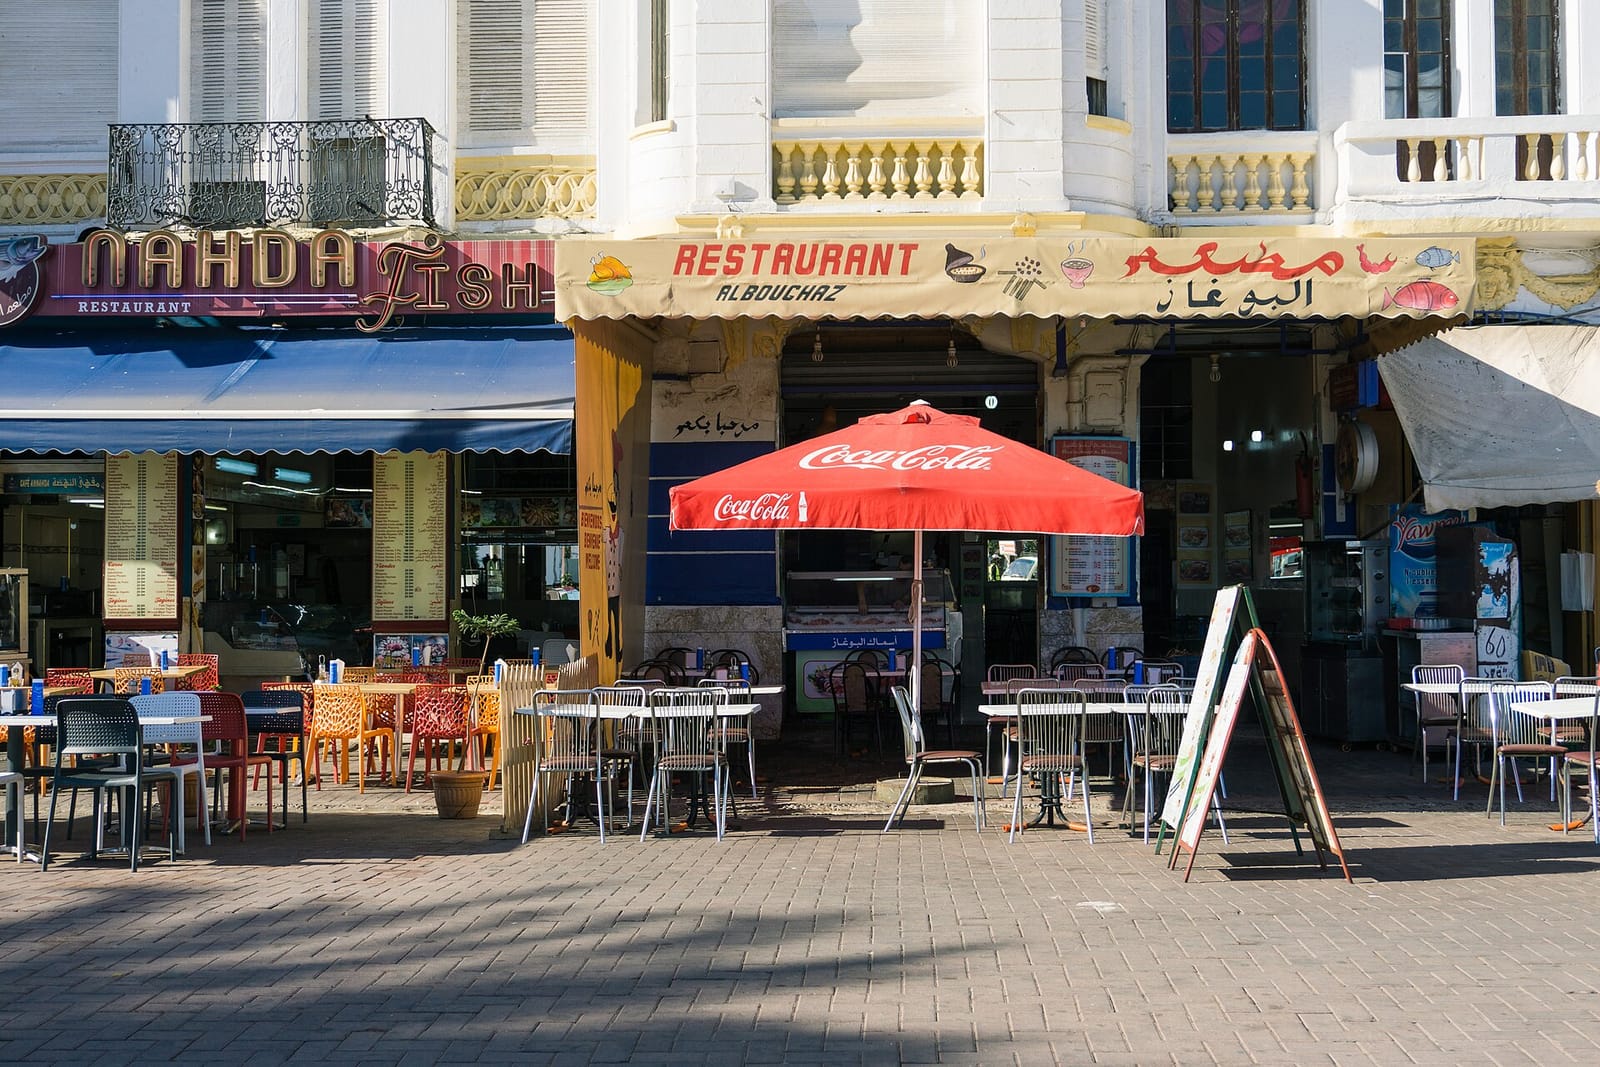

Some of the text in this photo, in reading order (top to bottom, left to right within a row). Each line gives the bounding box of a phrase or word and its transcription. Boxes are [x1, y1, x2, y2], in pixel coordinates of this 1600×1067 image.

[673, 243, 920, 276] RESTAURANT
[1119, 240, 1345, 280] مطعم
[82, 229, 539, 333] NAHDA FISH
[78, 301, 192, 314] RESTAURANT
